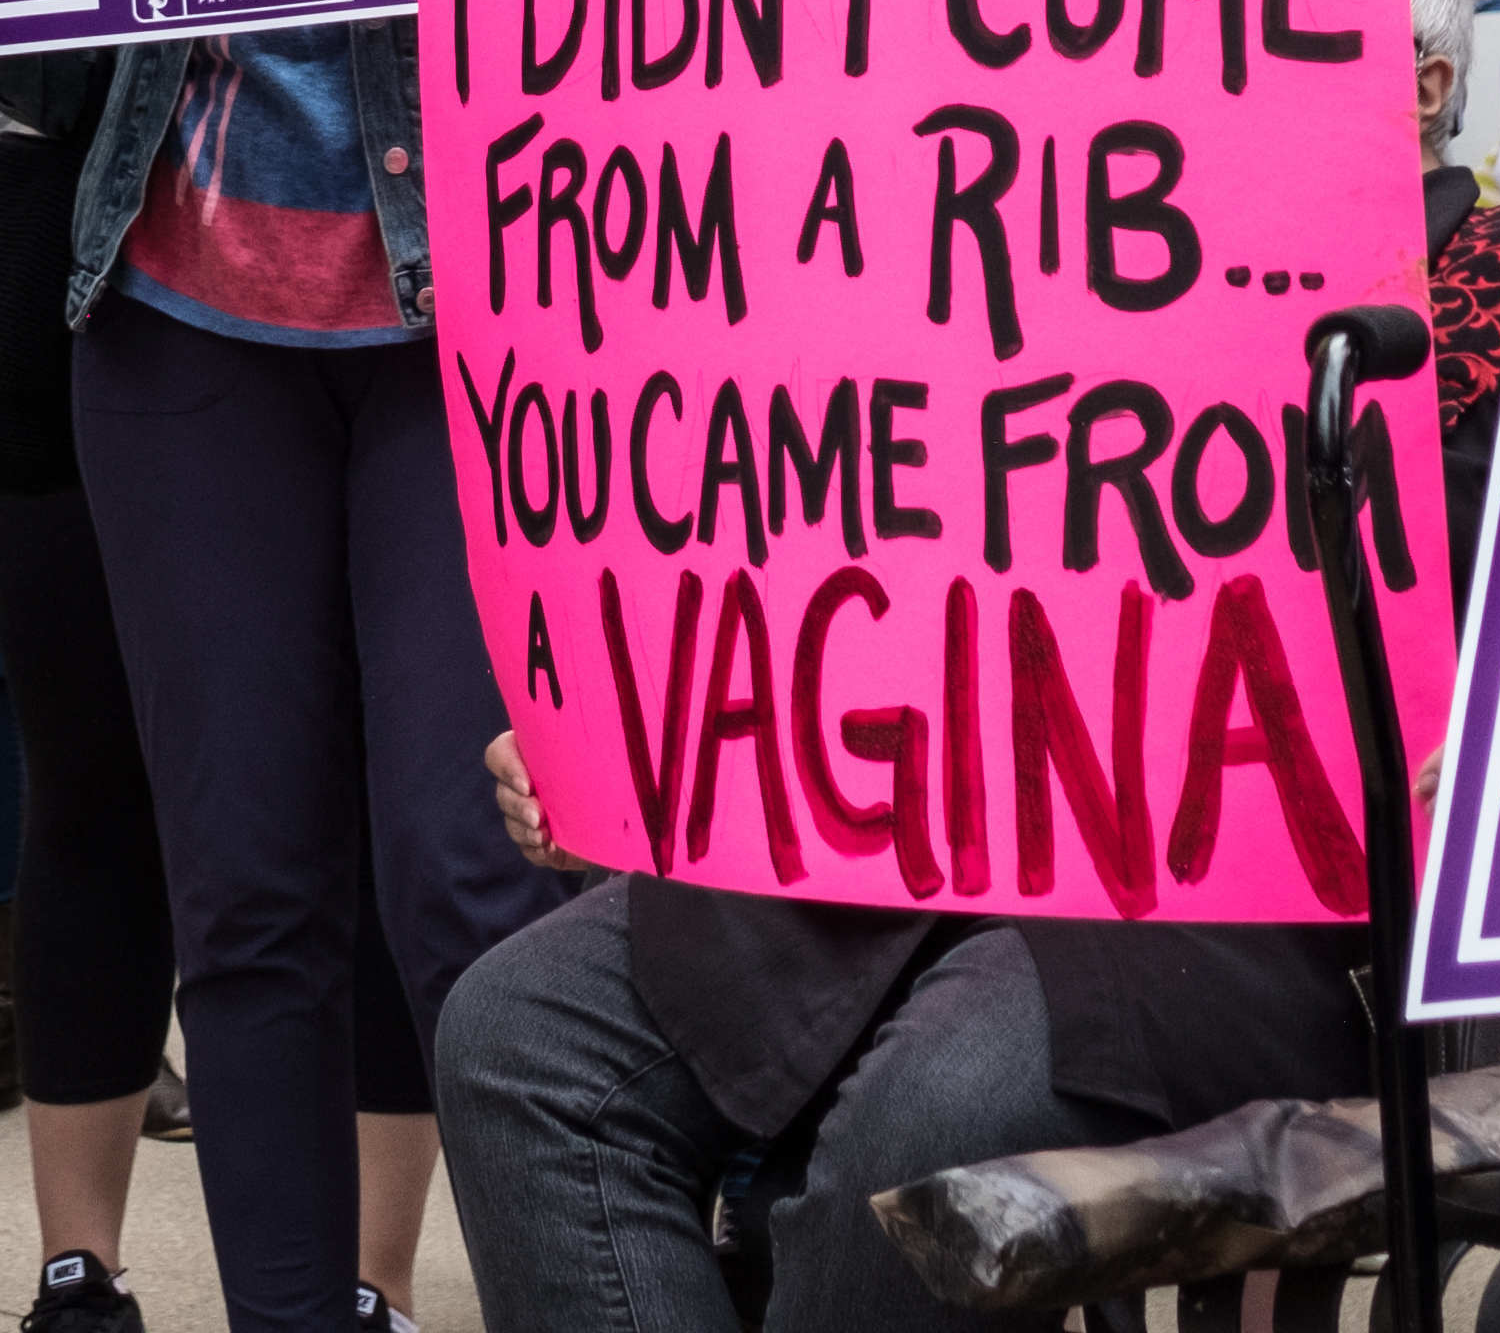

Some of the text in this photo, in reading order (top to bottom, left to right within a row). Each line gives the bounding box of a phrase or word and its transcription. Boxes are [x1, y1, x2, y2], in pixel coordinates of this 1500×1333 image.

[482, 113, 748, 355] FROM
[796, 137, 865, 279] A
[456, 347, 1418, 602] YOU CAME FROM
[526, 565, 1371, 921] A VAGINA
